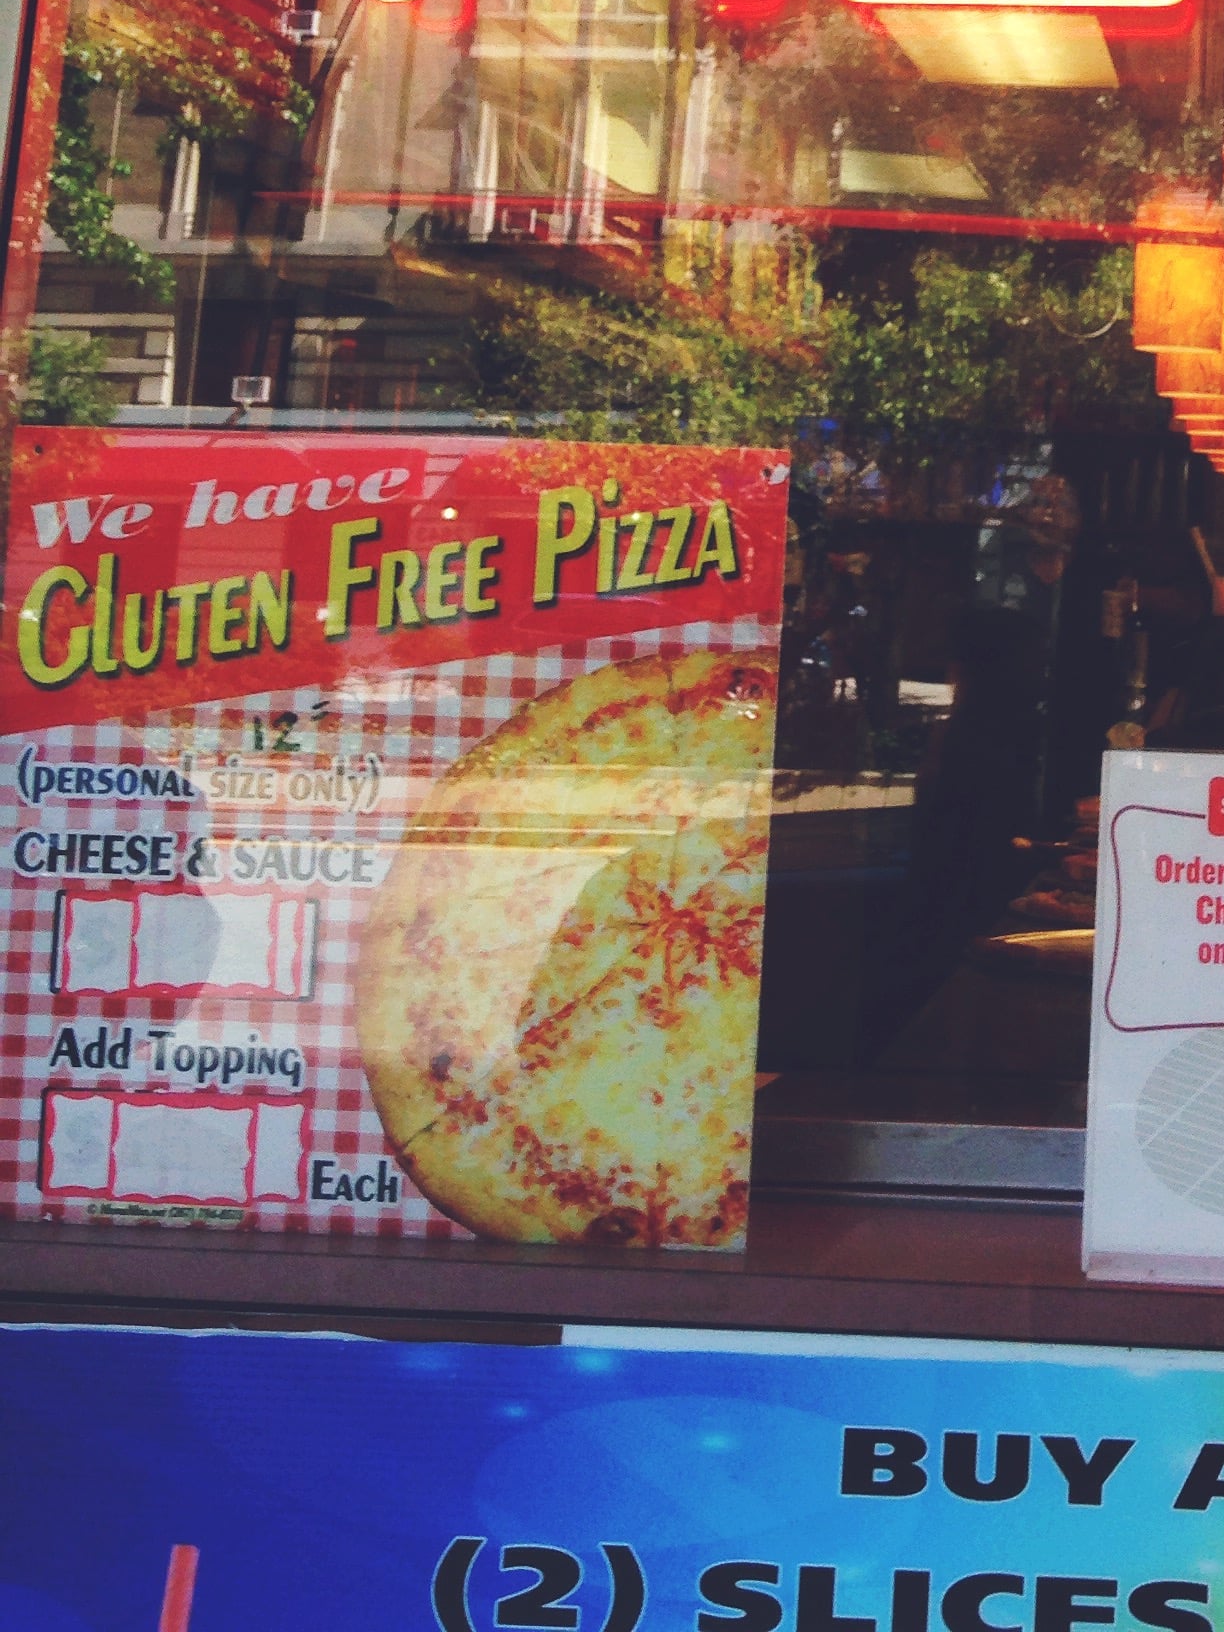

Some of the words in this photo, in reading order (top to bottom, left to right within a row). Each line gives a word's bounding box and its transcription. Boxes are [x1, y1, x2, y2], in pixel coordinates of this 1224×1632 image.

[31, 494, 153, 548] We
[185, 468, 410, 529] have
[325, 517, 503, 639] FREE
[14, 832, 173, 876] CHEESE
[186, 838, 220, 878] &
[234, 838, 374, 882] SAUCE
[50, 1027, 131, 1070] Add
[839, 1425, 1137, 1507] BUY
[430, 1535, 649, 1632] (2)
[699, 1559, 1210, 1632] SLICES
